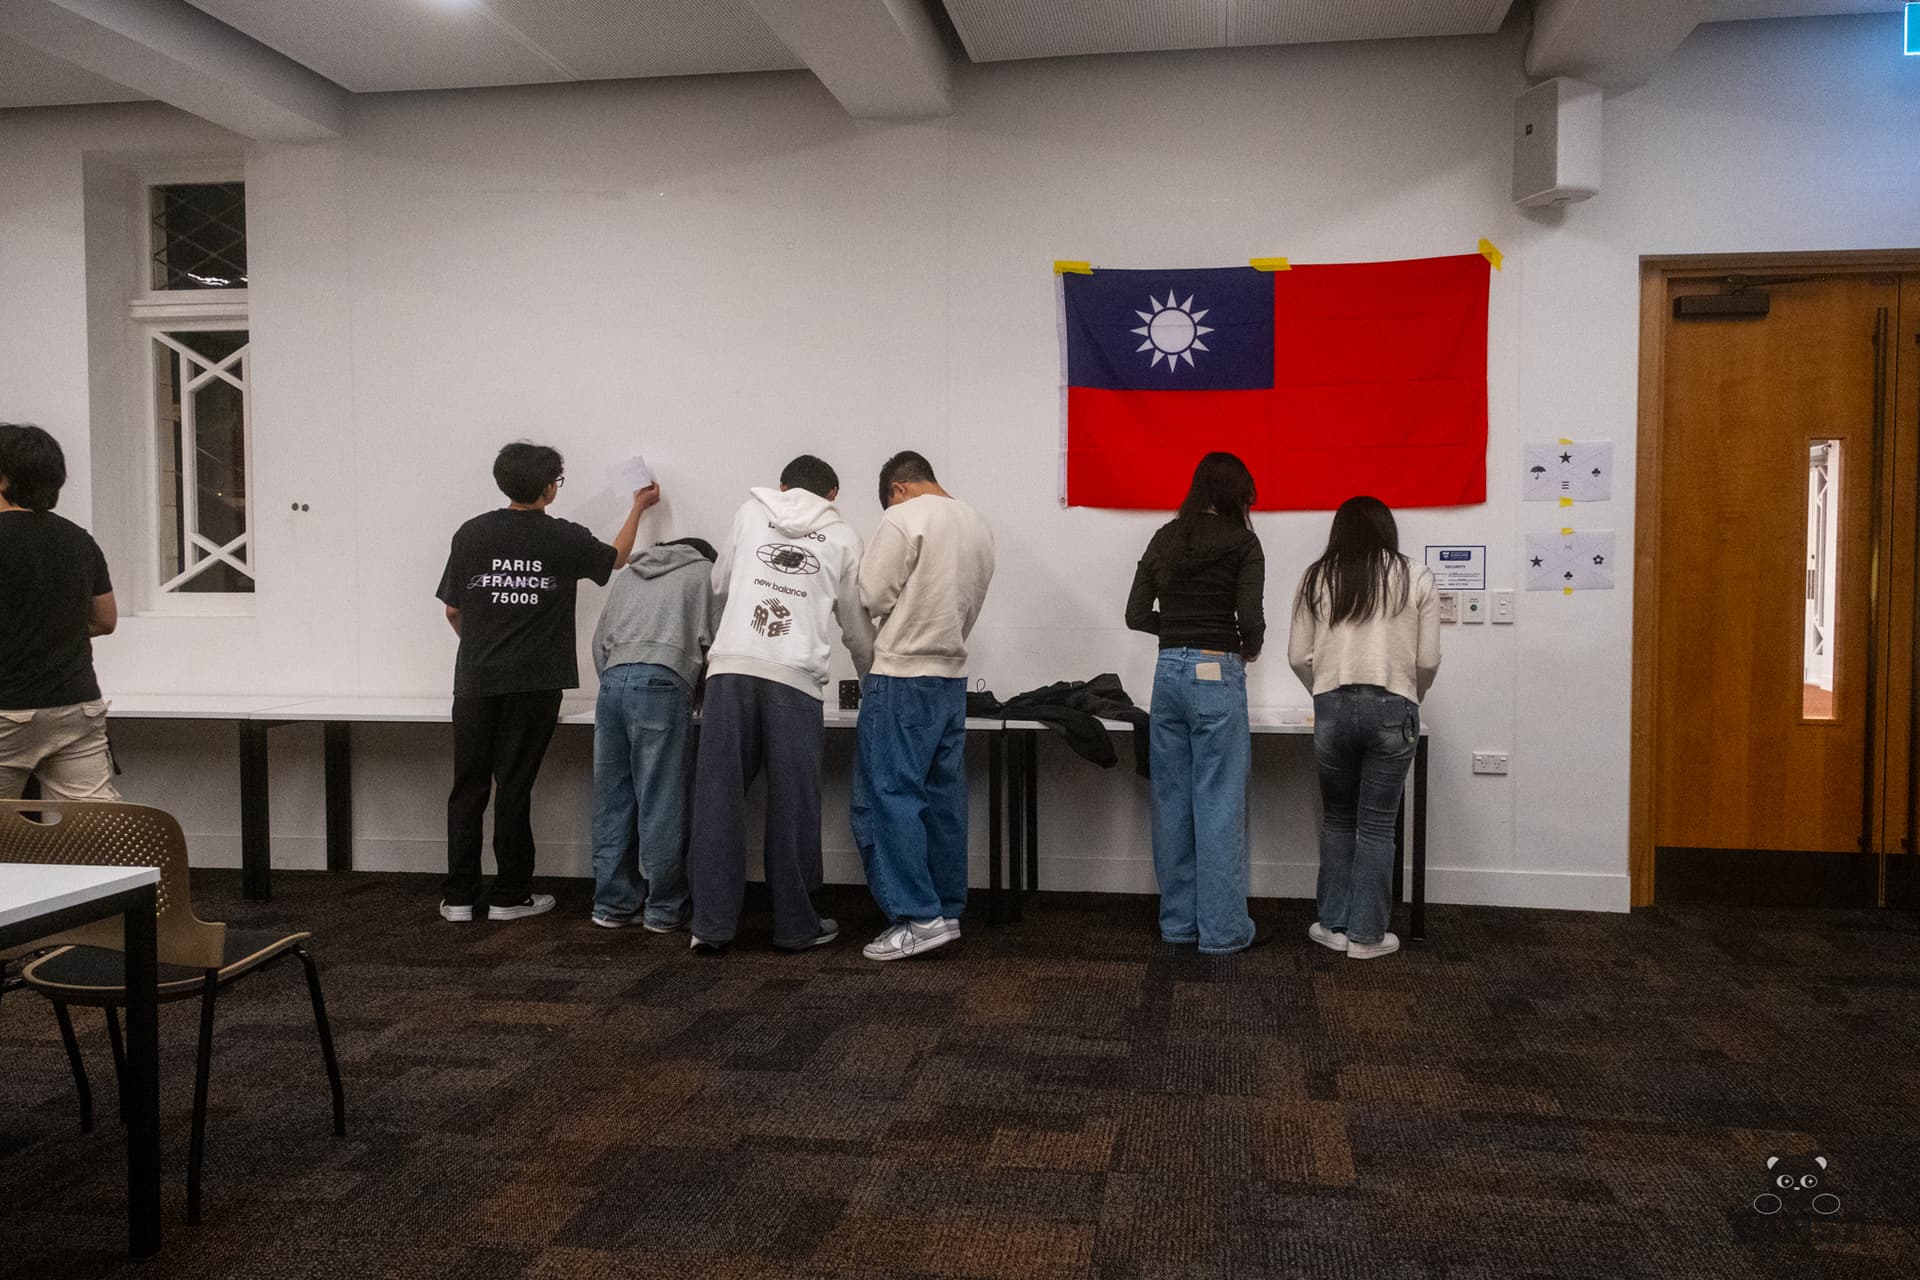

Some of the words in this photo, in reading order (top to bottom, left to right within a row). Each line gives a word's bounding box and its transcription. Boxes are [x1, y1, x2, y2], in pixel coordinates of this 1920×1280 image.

[492, 559, 543, 572] PARIS
[482, 575, 550, 588] FRANCE
[754, 578, 772, 587] new
[772, 582, 807, 598] balance
[491, 592, 538, 605] 75008
